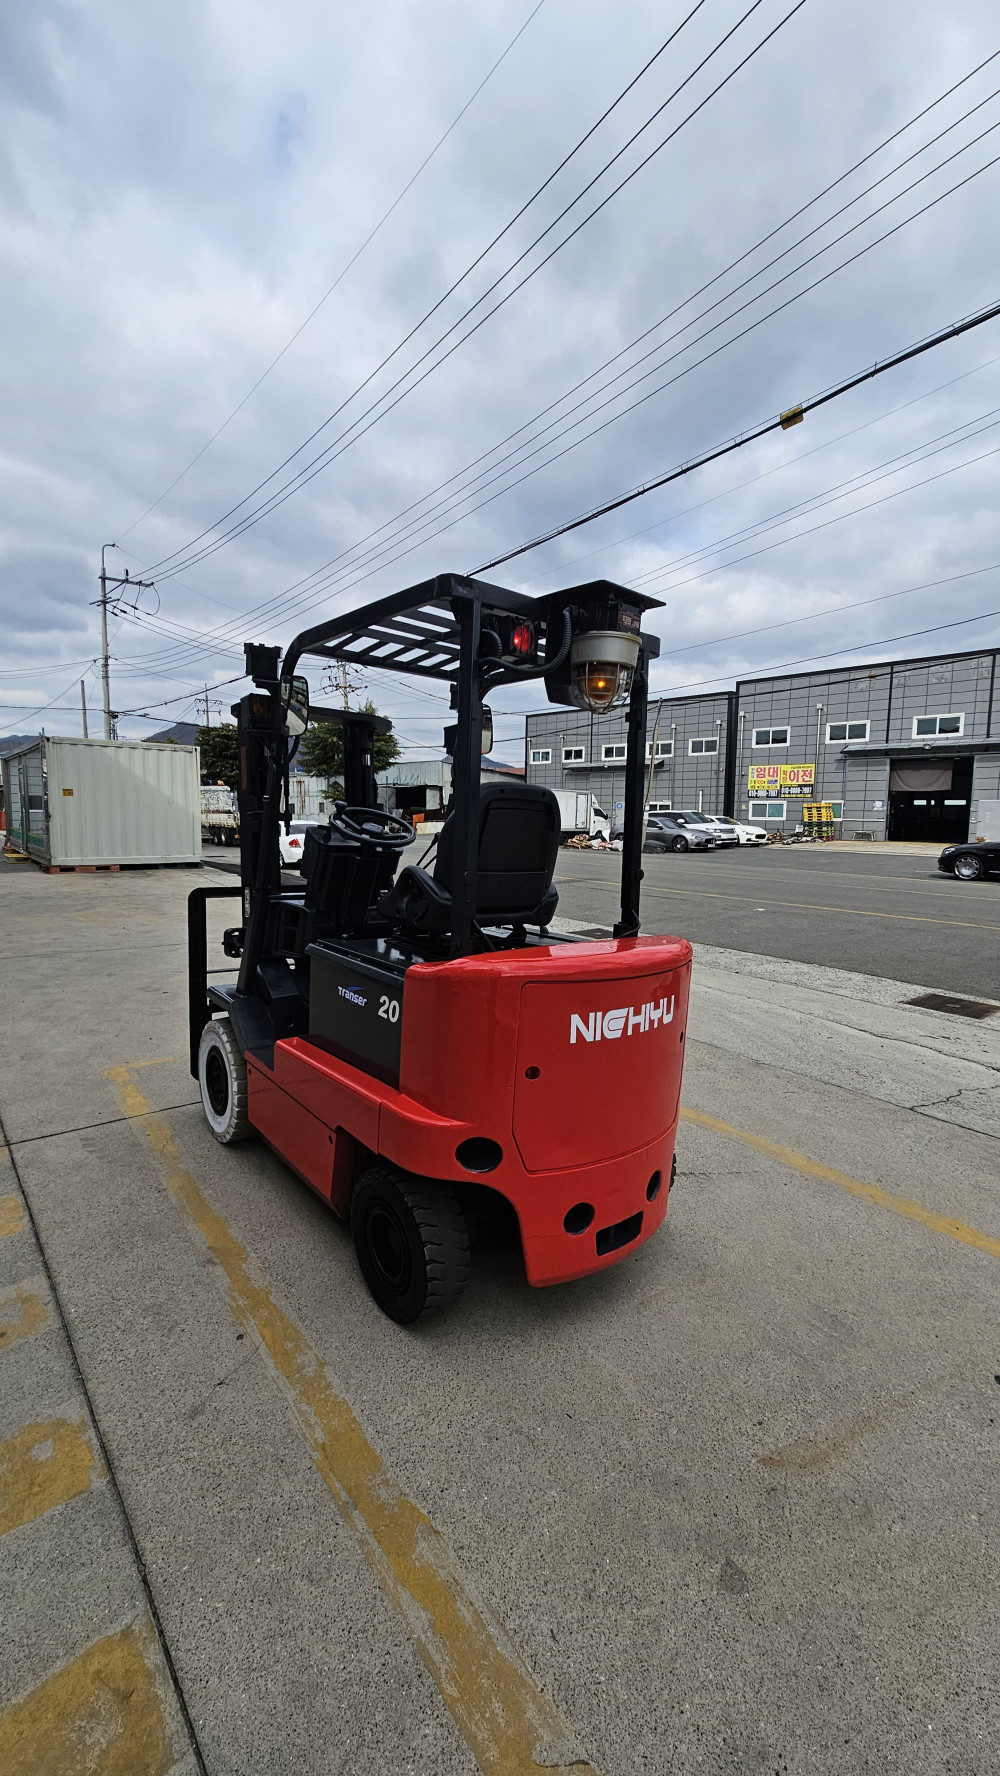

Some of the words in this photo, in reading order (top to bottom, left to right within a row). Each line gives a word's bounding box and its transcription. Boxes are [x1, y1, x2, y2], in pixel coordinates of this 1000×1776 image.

[756, 766, 779, 778] 임대
[788, 769, 813, 783] 이전
[377, 995, 400, 1023] 20
[569, 994, 675, 1044] NICHIYU
